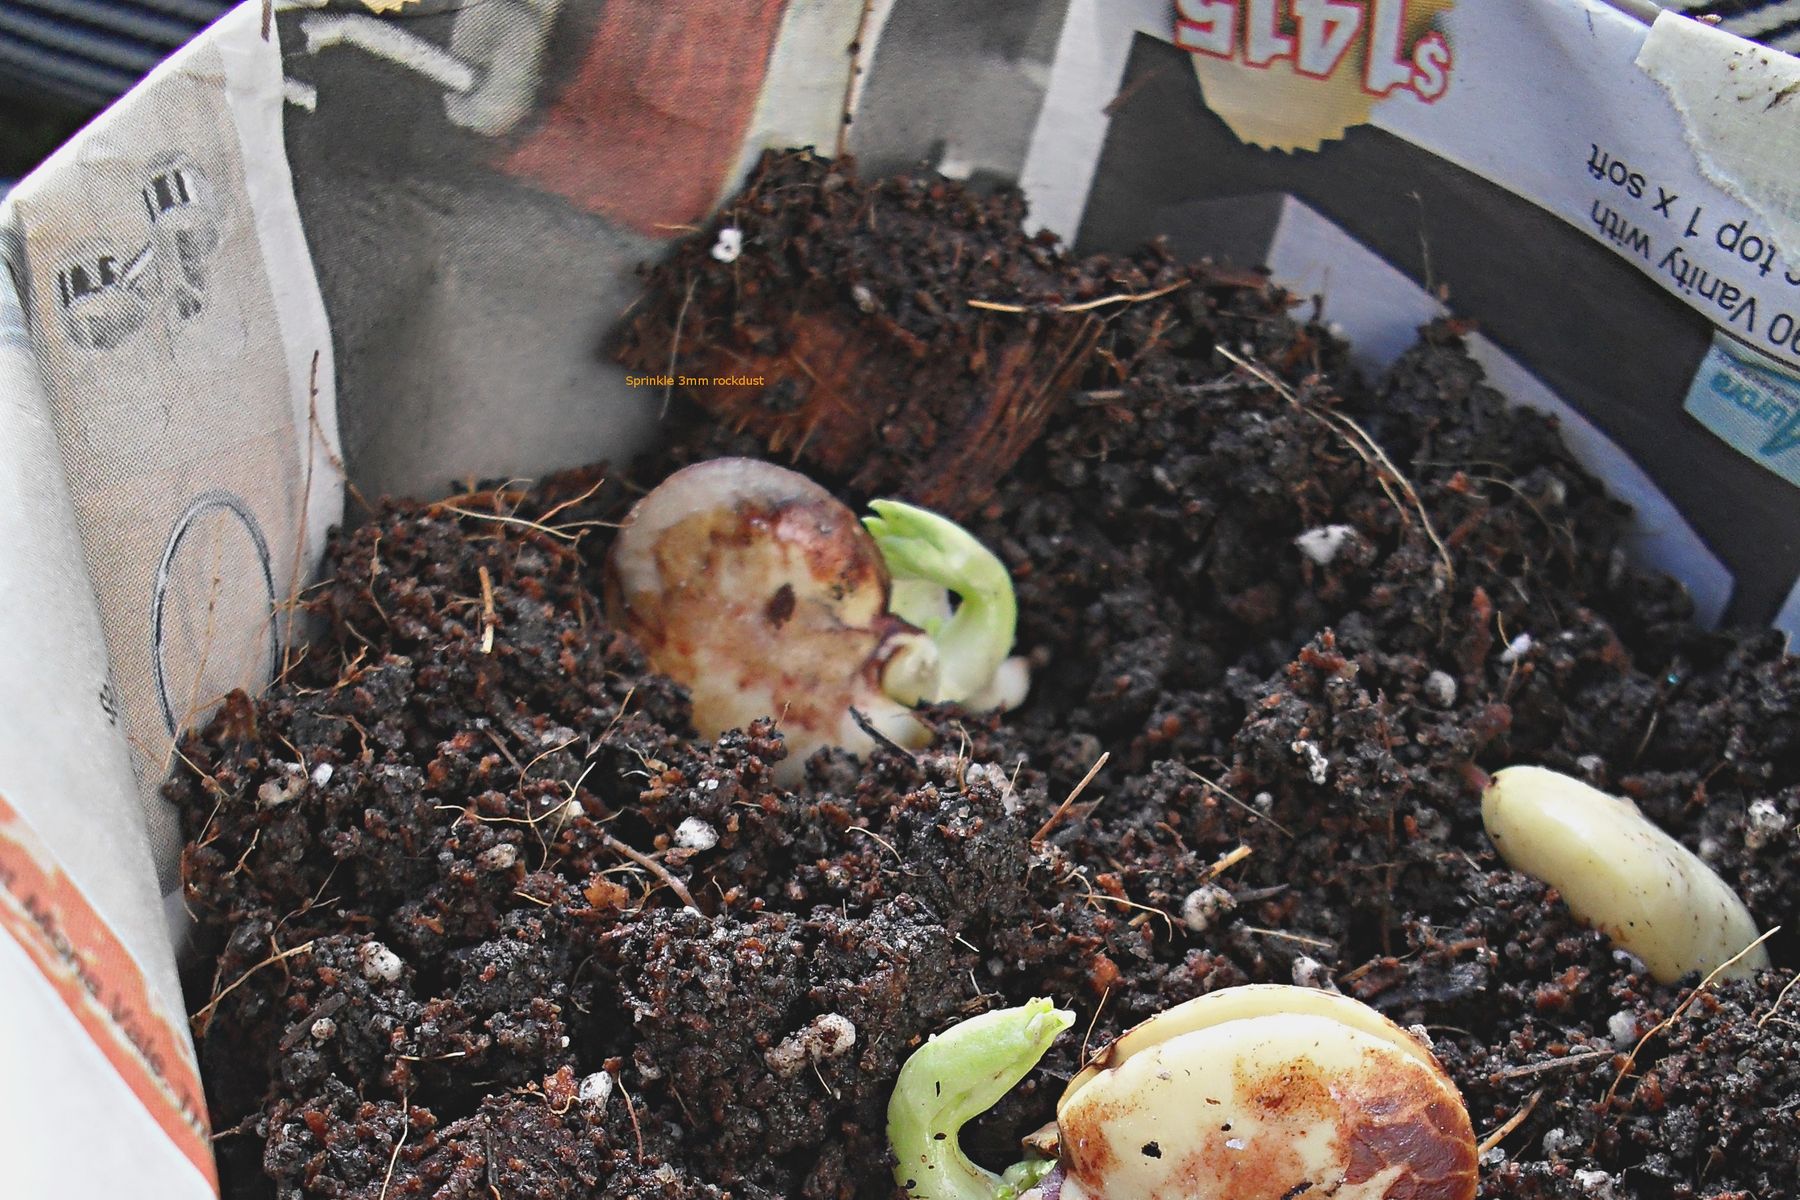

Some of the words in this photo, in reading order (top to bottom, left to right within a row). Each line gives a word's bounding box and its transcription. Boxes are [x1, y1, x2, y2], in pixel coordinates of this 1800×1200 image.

[1174, 0, 1453, 105] $1415
[1586, 142, 1647, 200] soft
[1590, 199, 1650, 260] with
[1651, 186, 1680, 219] x
[1715, 220, 1777, 278] top
[1658, 246, 1756, 333] Vanity
